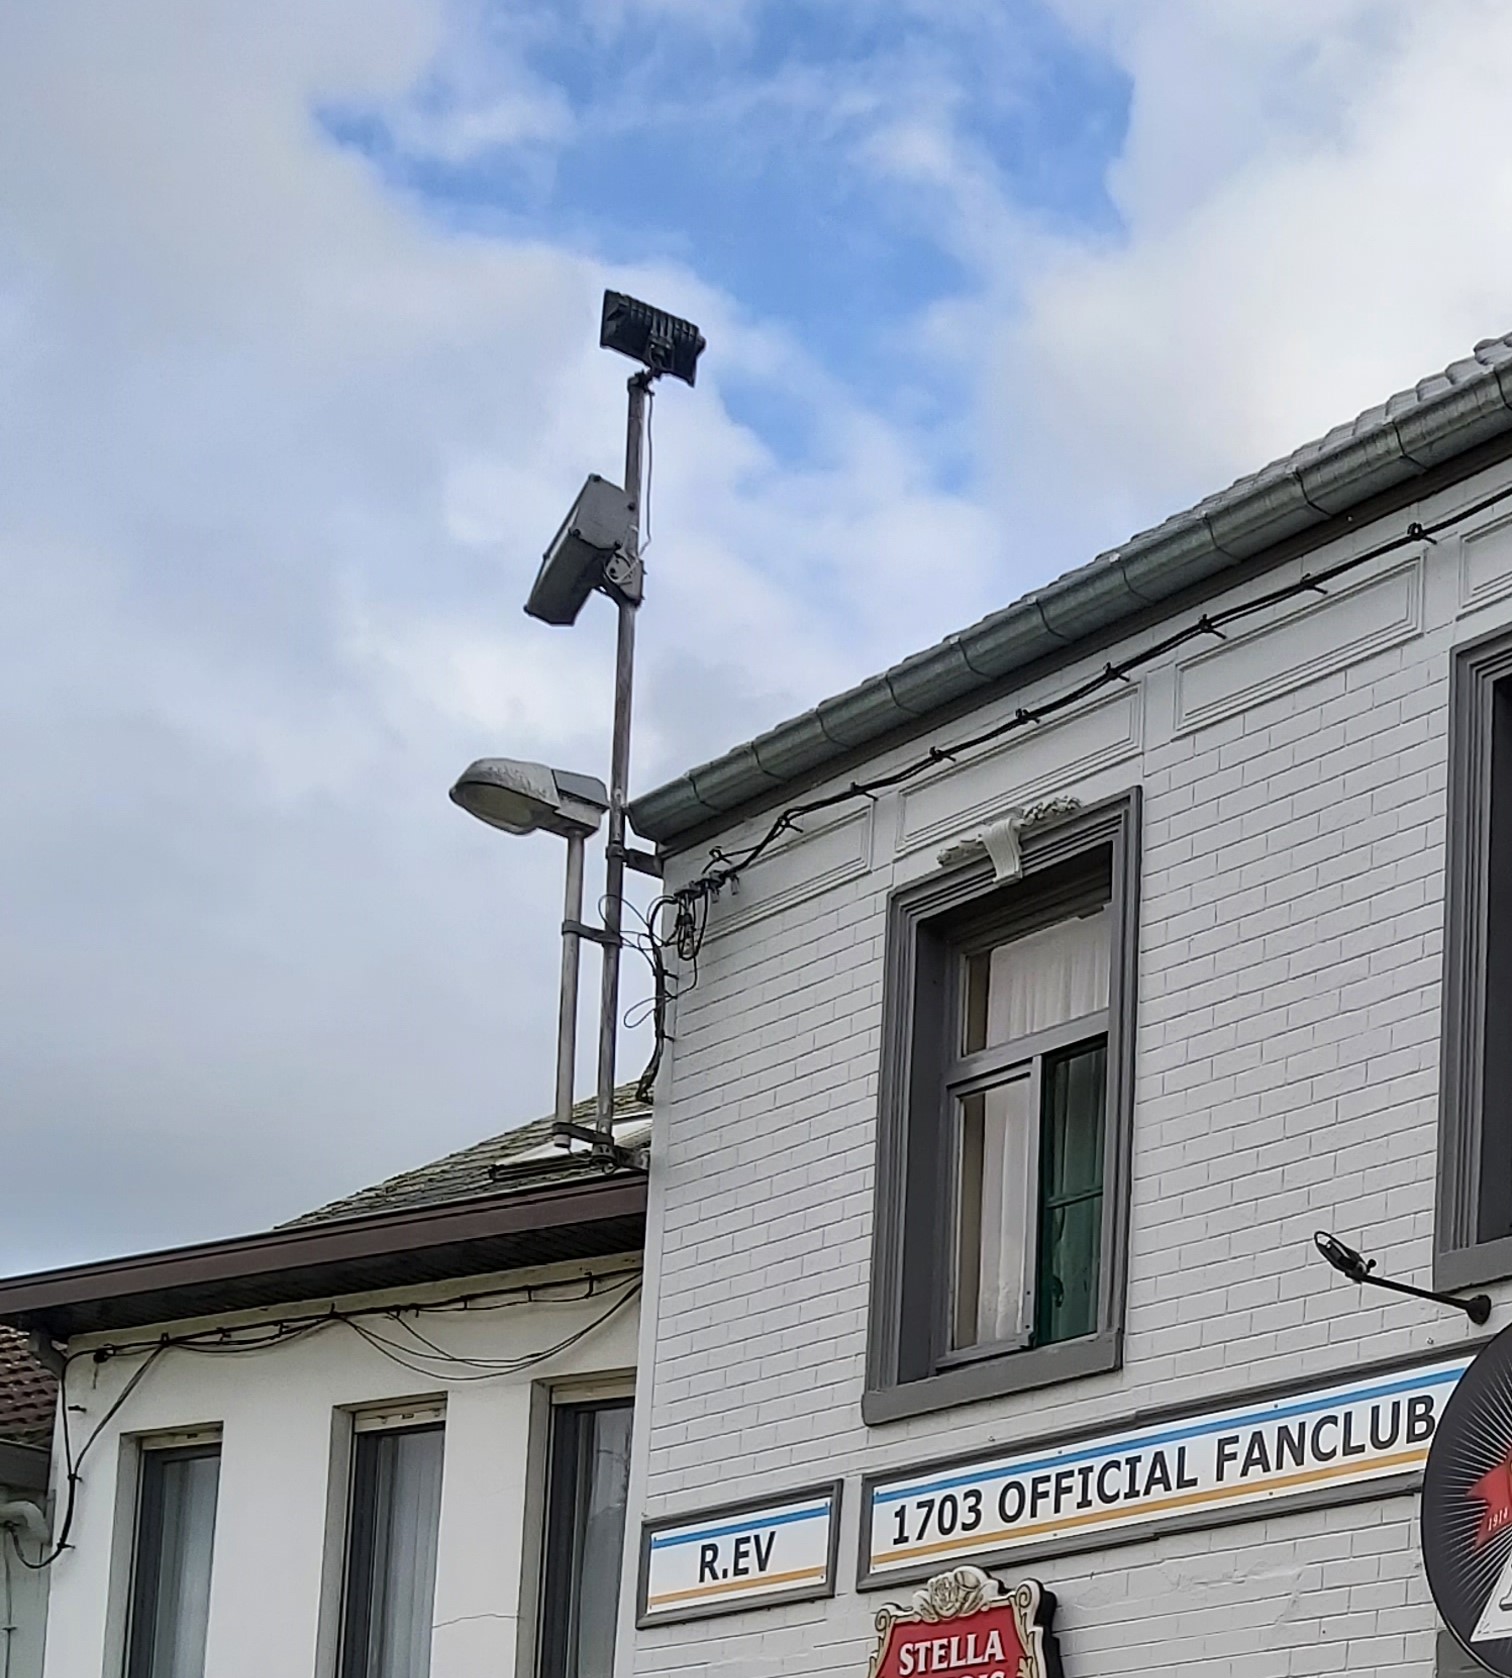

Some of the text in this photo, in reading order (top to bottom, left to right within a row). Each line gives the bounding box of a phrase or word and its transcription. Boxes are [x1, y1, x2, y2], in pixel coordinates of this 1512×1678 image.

[892, 1393, 1436, 1546] 1703 OFFICIAL FANCLUB
[1487, 1506, 1509, 1531] 1914
[698, 1530, 777, 1584] R.EV
[899, 1630, 1006, 1677] STELLA
